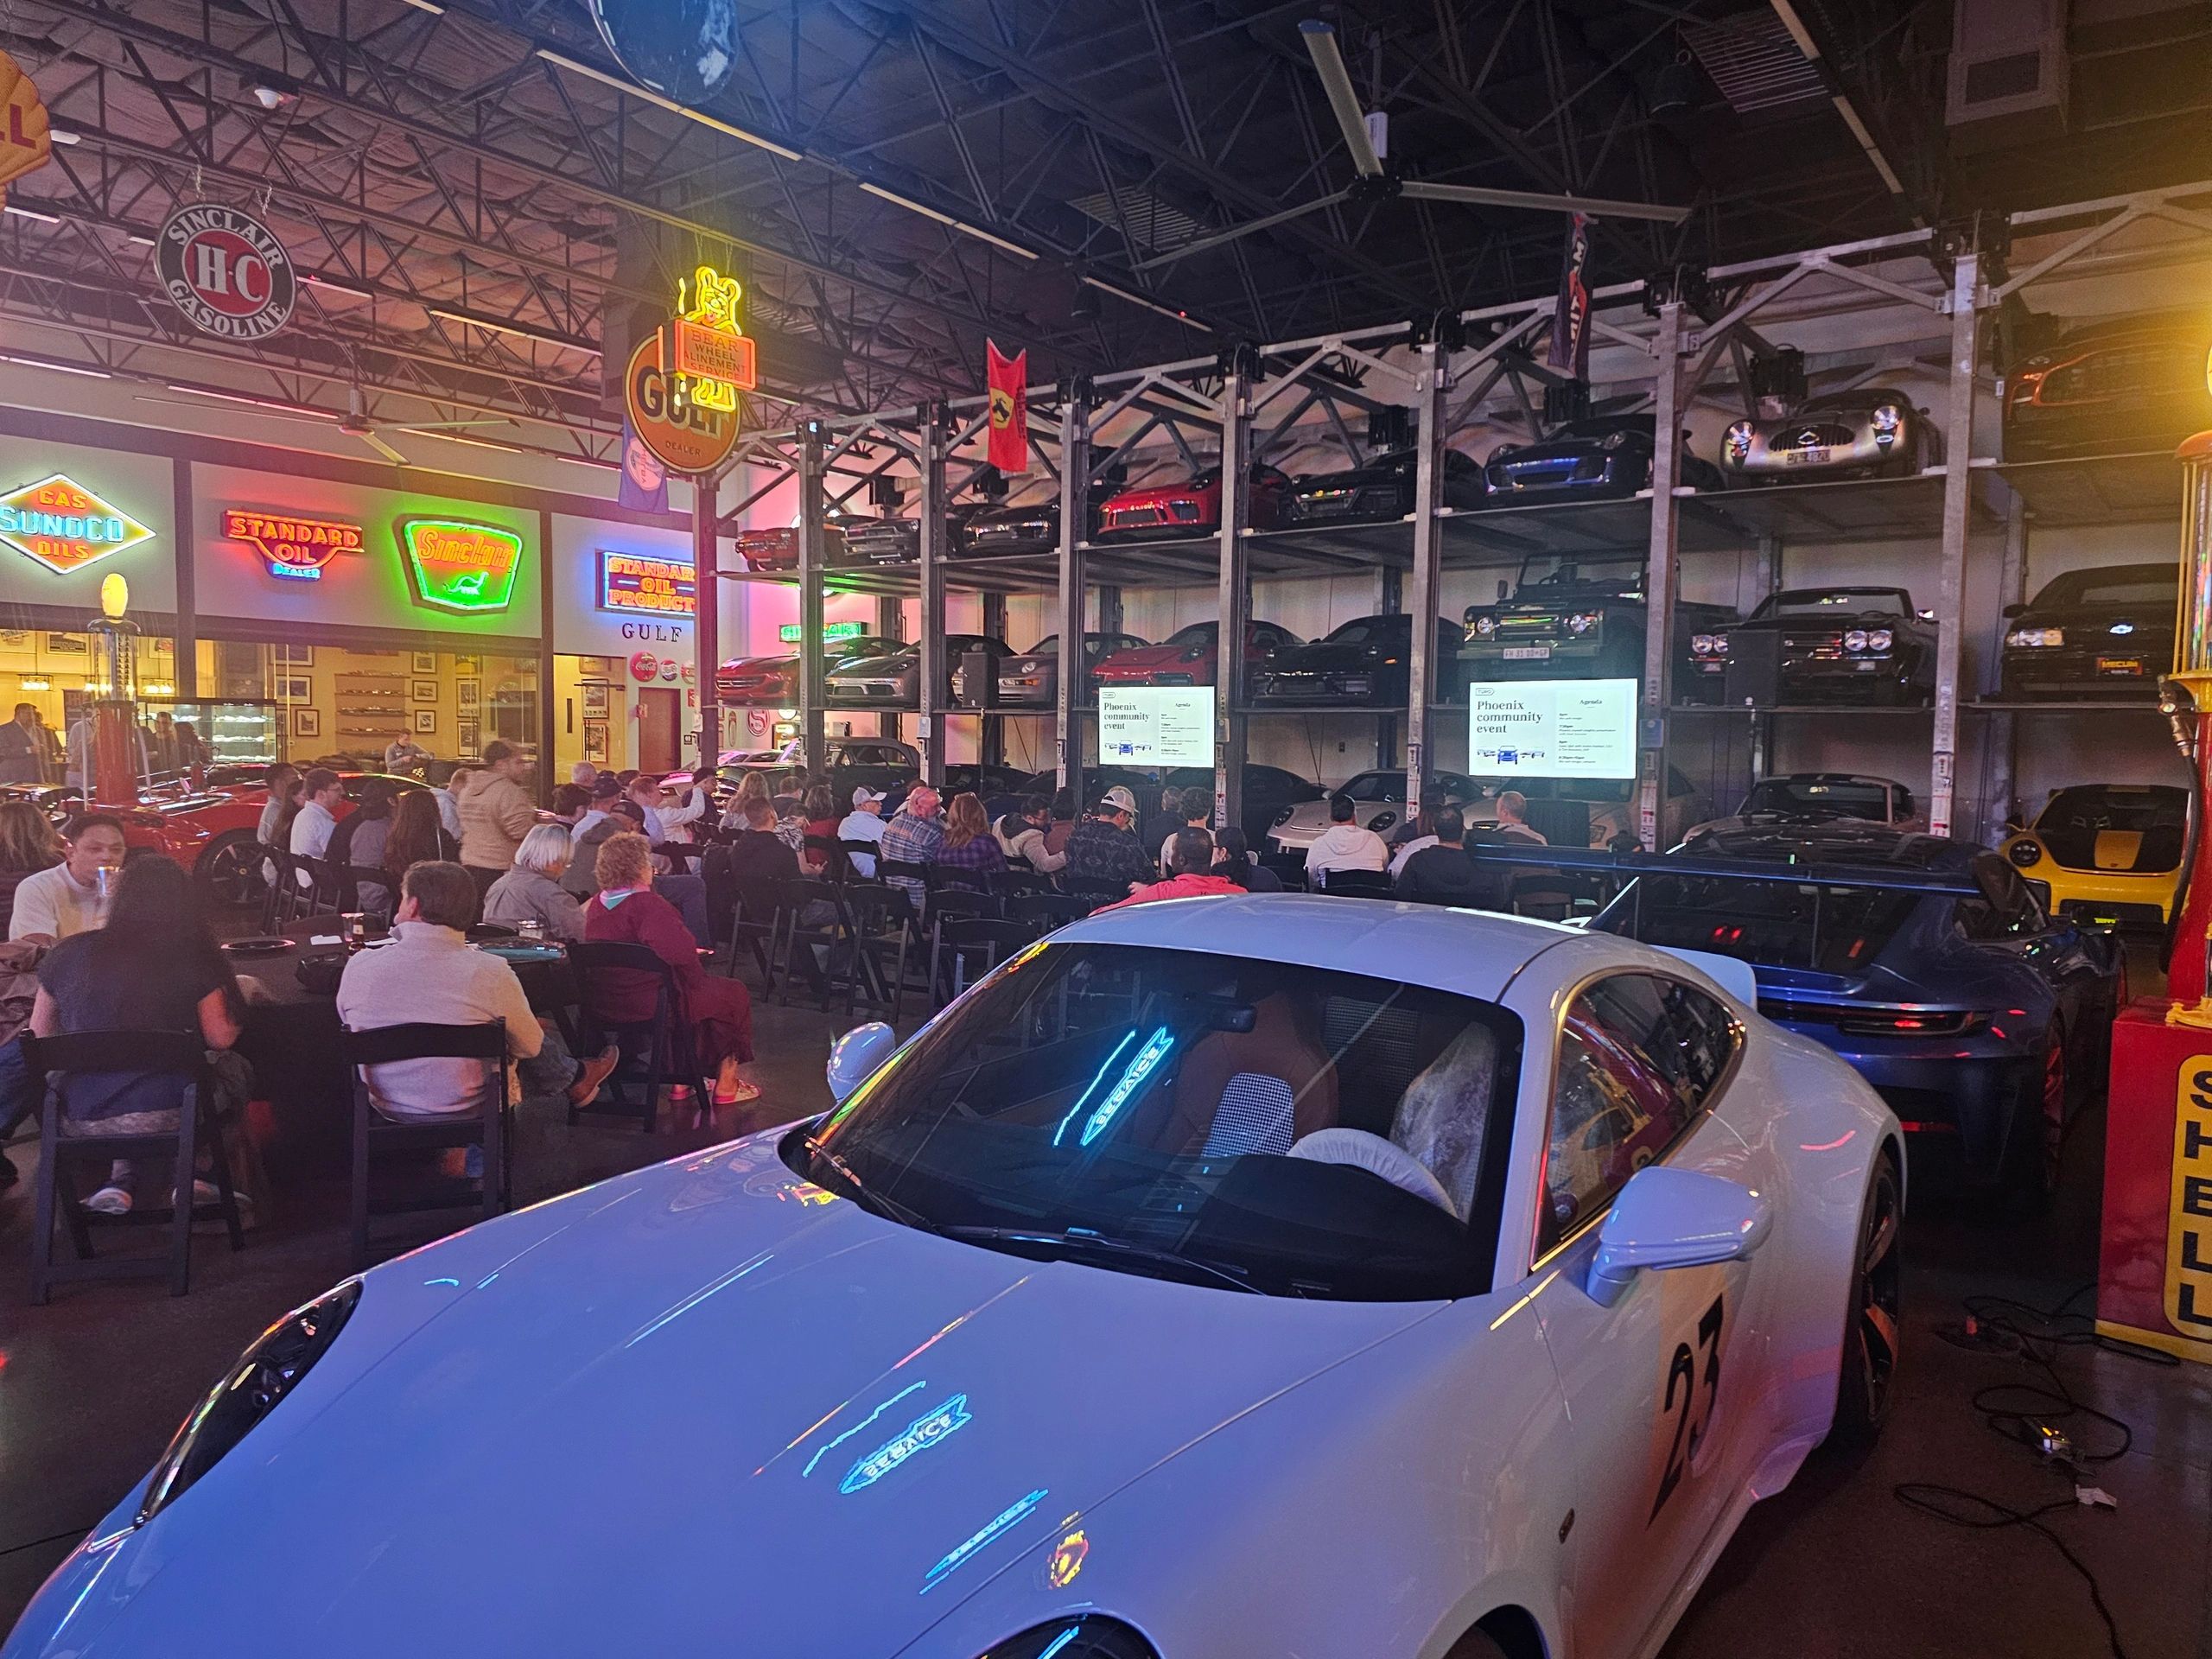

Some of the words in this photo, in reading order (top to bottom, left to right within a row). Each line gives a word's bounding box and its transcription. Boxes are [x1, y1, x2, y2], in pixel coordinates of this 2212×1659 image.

[167, 208, 283, 270] SINCLAIR
[168, 278, 287, 336] GASOLINE
[690, 329, 739, 353] BEAR
[683, 351, 747, 374] ALINEMENT
[695, 343, 736, 362] WHEEL
[690, 363, 741, 381] SERVICE
[665, 441, 701, 456] DEALER
[38, 489, 87, 510] GAS
[0, 505, 124, 543] SUNOCO
[230, 517, 359, 548] STANDARD
[37, 540, 90, 560] OILS
[274, 543, 317, 563] OIL
[419, 528, 516, 569] Sinclair
[272, 563, 321, 579] DEALER
[607, 556, 696, 582] STANDAR
[640, 576, 677, 595] OIL
[607, 588, 696, 613] PRODUCT
[621, 622, 683, 643] GULF
[1103, 702, 1137, 711] Phoenix
[1477, 699, 1525, 710] Phoenix
[1103, 712, 1150, 722] community
[1476, 711, 1544, 724] community
[1476, 724, 1508, 734] event
[2177, 1070, 2212, 1326] SHELL
[1644, 1292, 1725, 1532] 23
